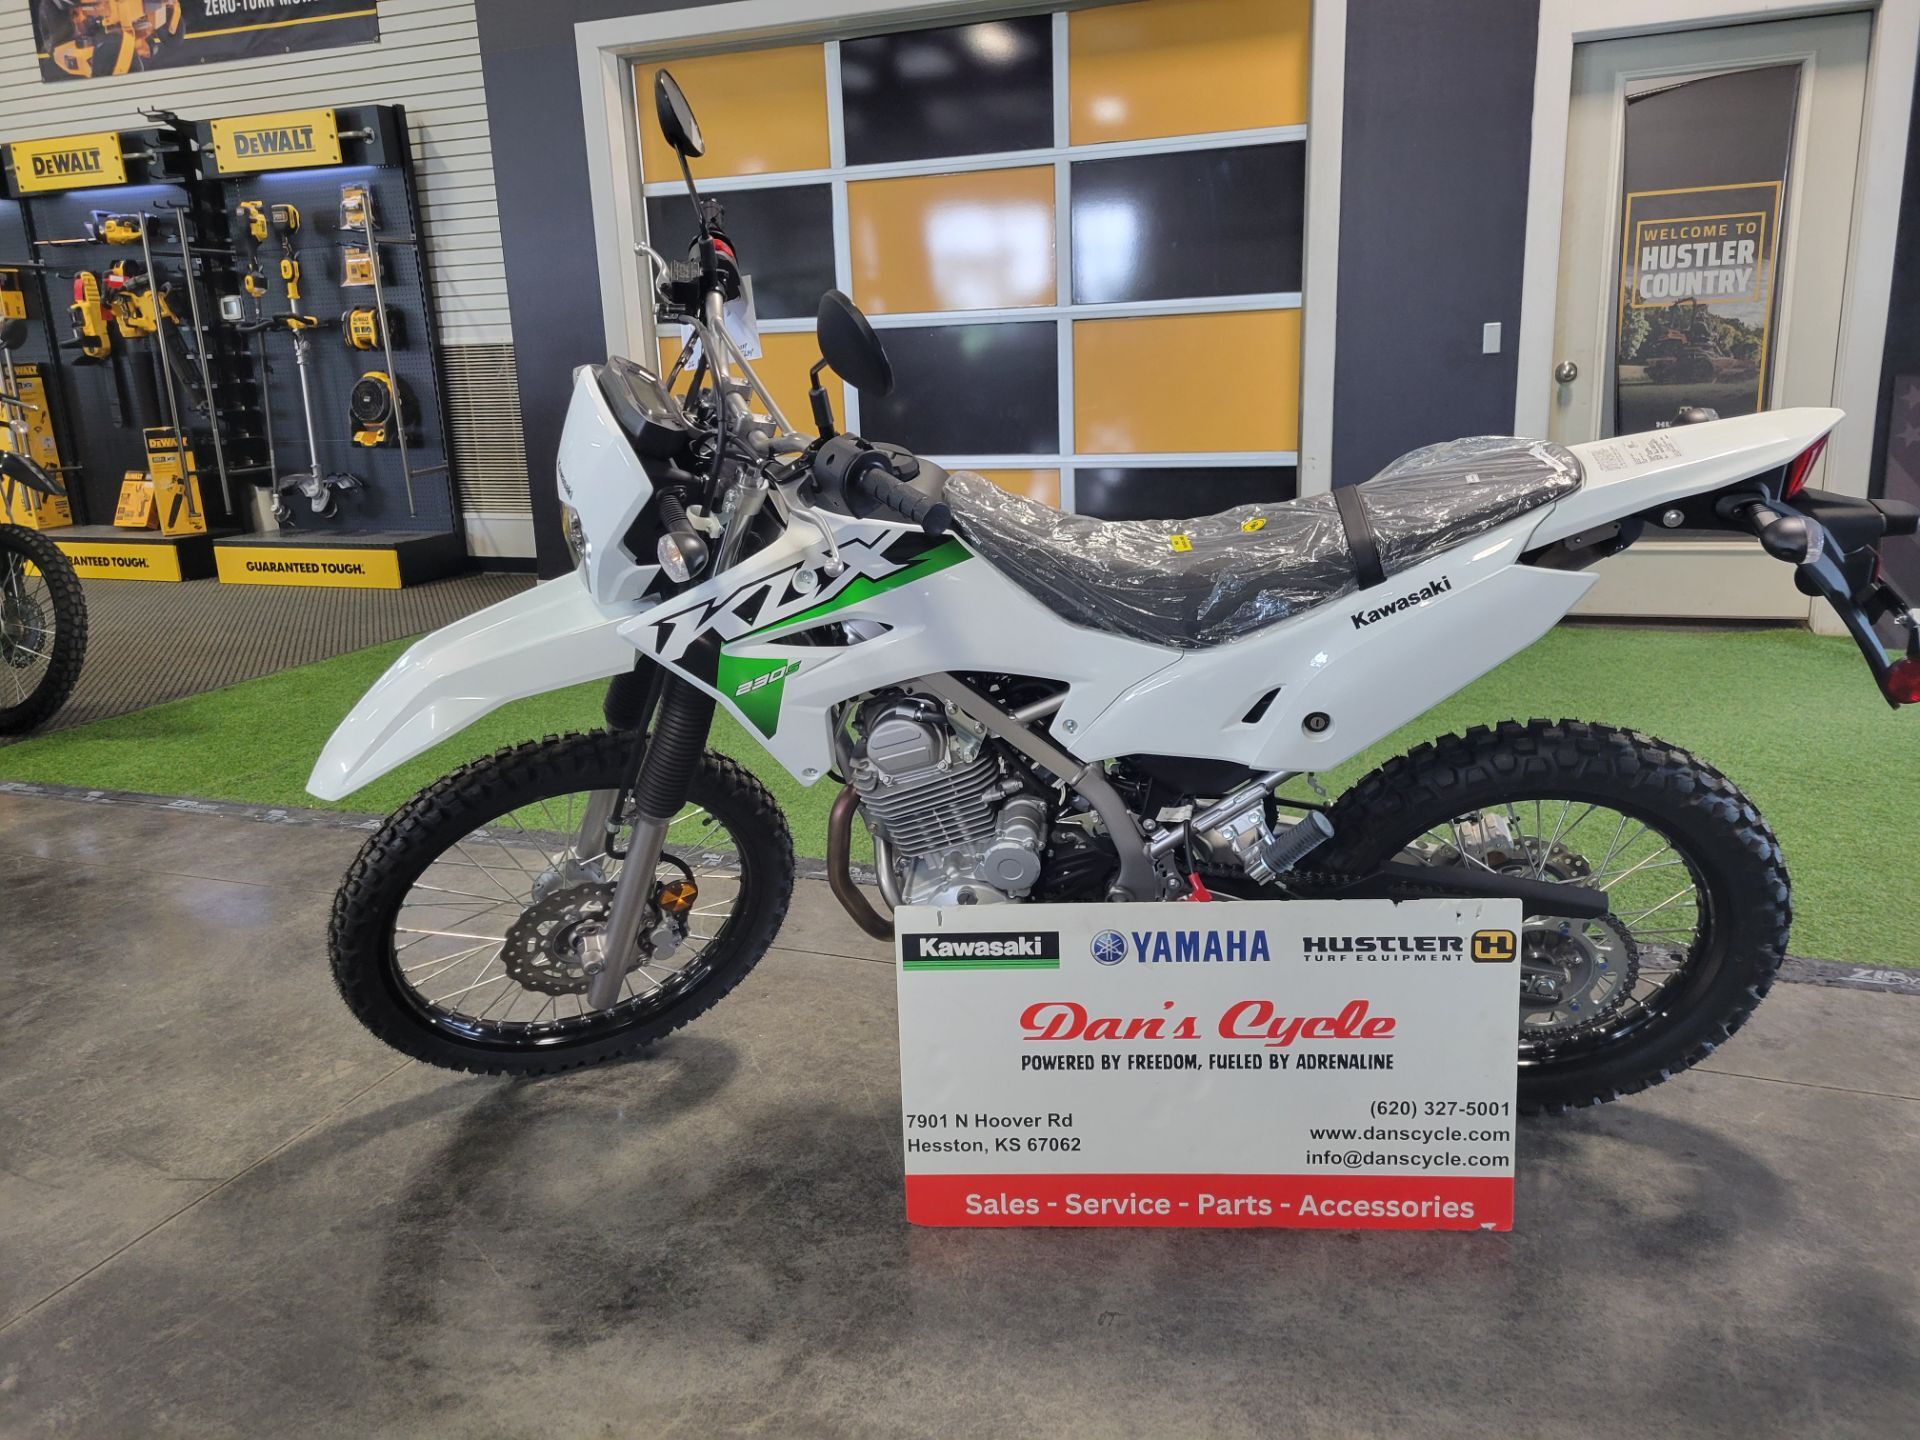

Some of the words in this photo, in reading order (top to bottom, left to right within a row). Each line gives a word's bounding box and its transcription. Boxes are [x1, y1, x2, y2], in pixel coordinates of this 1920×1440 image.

[1644, 224, 1728, 241] WELCOME
[1735, 222, 1757, 235] TO
[1641, 239, 1755, 271] HUSTLER
[1639, 268, 1752, 298] COUNTRY
[66, 556, 110, 567] RANTEED
[246, 561, 319, 574] GUARANTEED
[1350, 575, 1452, 630] Kawasaki
[919, 936, 1042, 957] Kawasaki
[1131, 930, 1271, 963] YAMAHA
[1302, 936, 1464, 952] HUSTLER
[1304, 954, 1347, 962] TURF
[1356, 954, 1463, 962] EQUIPMENT
[1019, 1000, 1201, 1042] Dan's
[1218, 999, 1397, 1048] Cycle
[1021, 1054, 1095, 1071] POWERED
[1101, 1054, 1122, 1070] BY
[1127, 1053, 1203, 1071] FREEDOM,
[1209, 1053, 1263, 1070] FUELED
[1269, 1053, 1290, 1070] BY
[1296, 1053, 1394, 1070] ADRENALINE
[1370, 1100, 1417, 1119] (620)
[1424, 1101, 1509, 1116] 327-5001
[906, 1113, 947, 1128] 7901
[955, 1113, 968, 1128] N
[975, 1113, 1042, 1128] Hoover
[1048, 1113, 1073, 1128] Rd
[1310, 1125, 1510, 1145] www.danscycle.com
[908, 1138, 989, 1154] Hesston,
[995, 1137, 1021, 1152] KS
[1027, 1137, 1081, 1152] 67062
[1306, 1150, 1509, 1169] info@danscycle.com
[965, 1192, 1040, 1215] Sales
[1065, 1192, 1171, 1215] Service
[1198, 1193, 1273, 1216] Parts
[1298, 1194, 1475, 1219] Accessories
